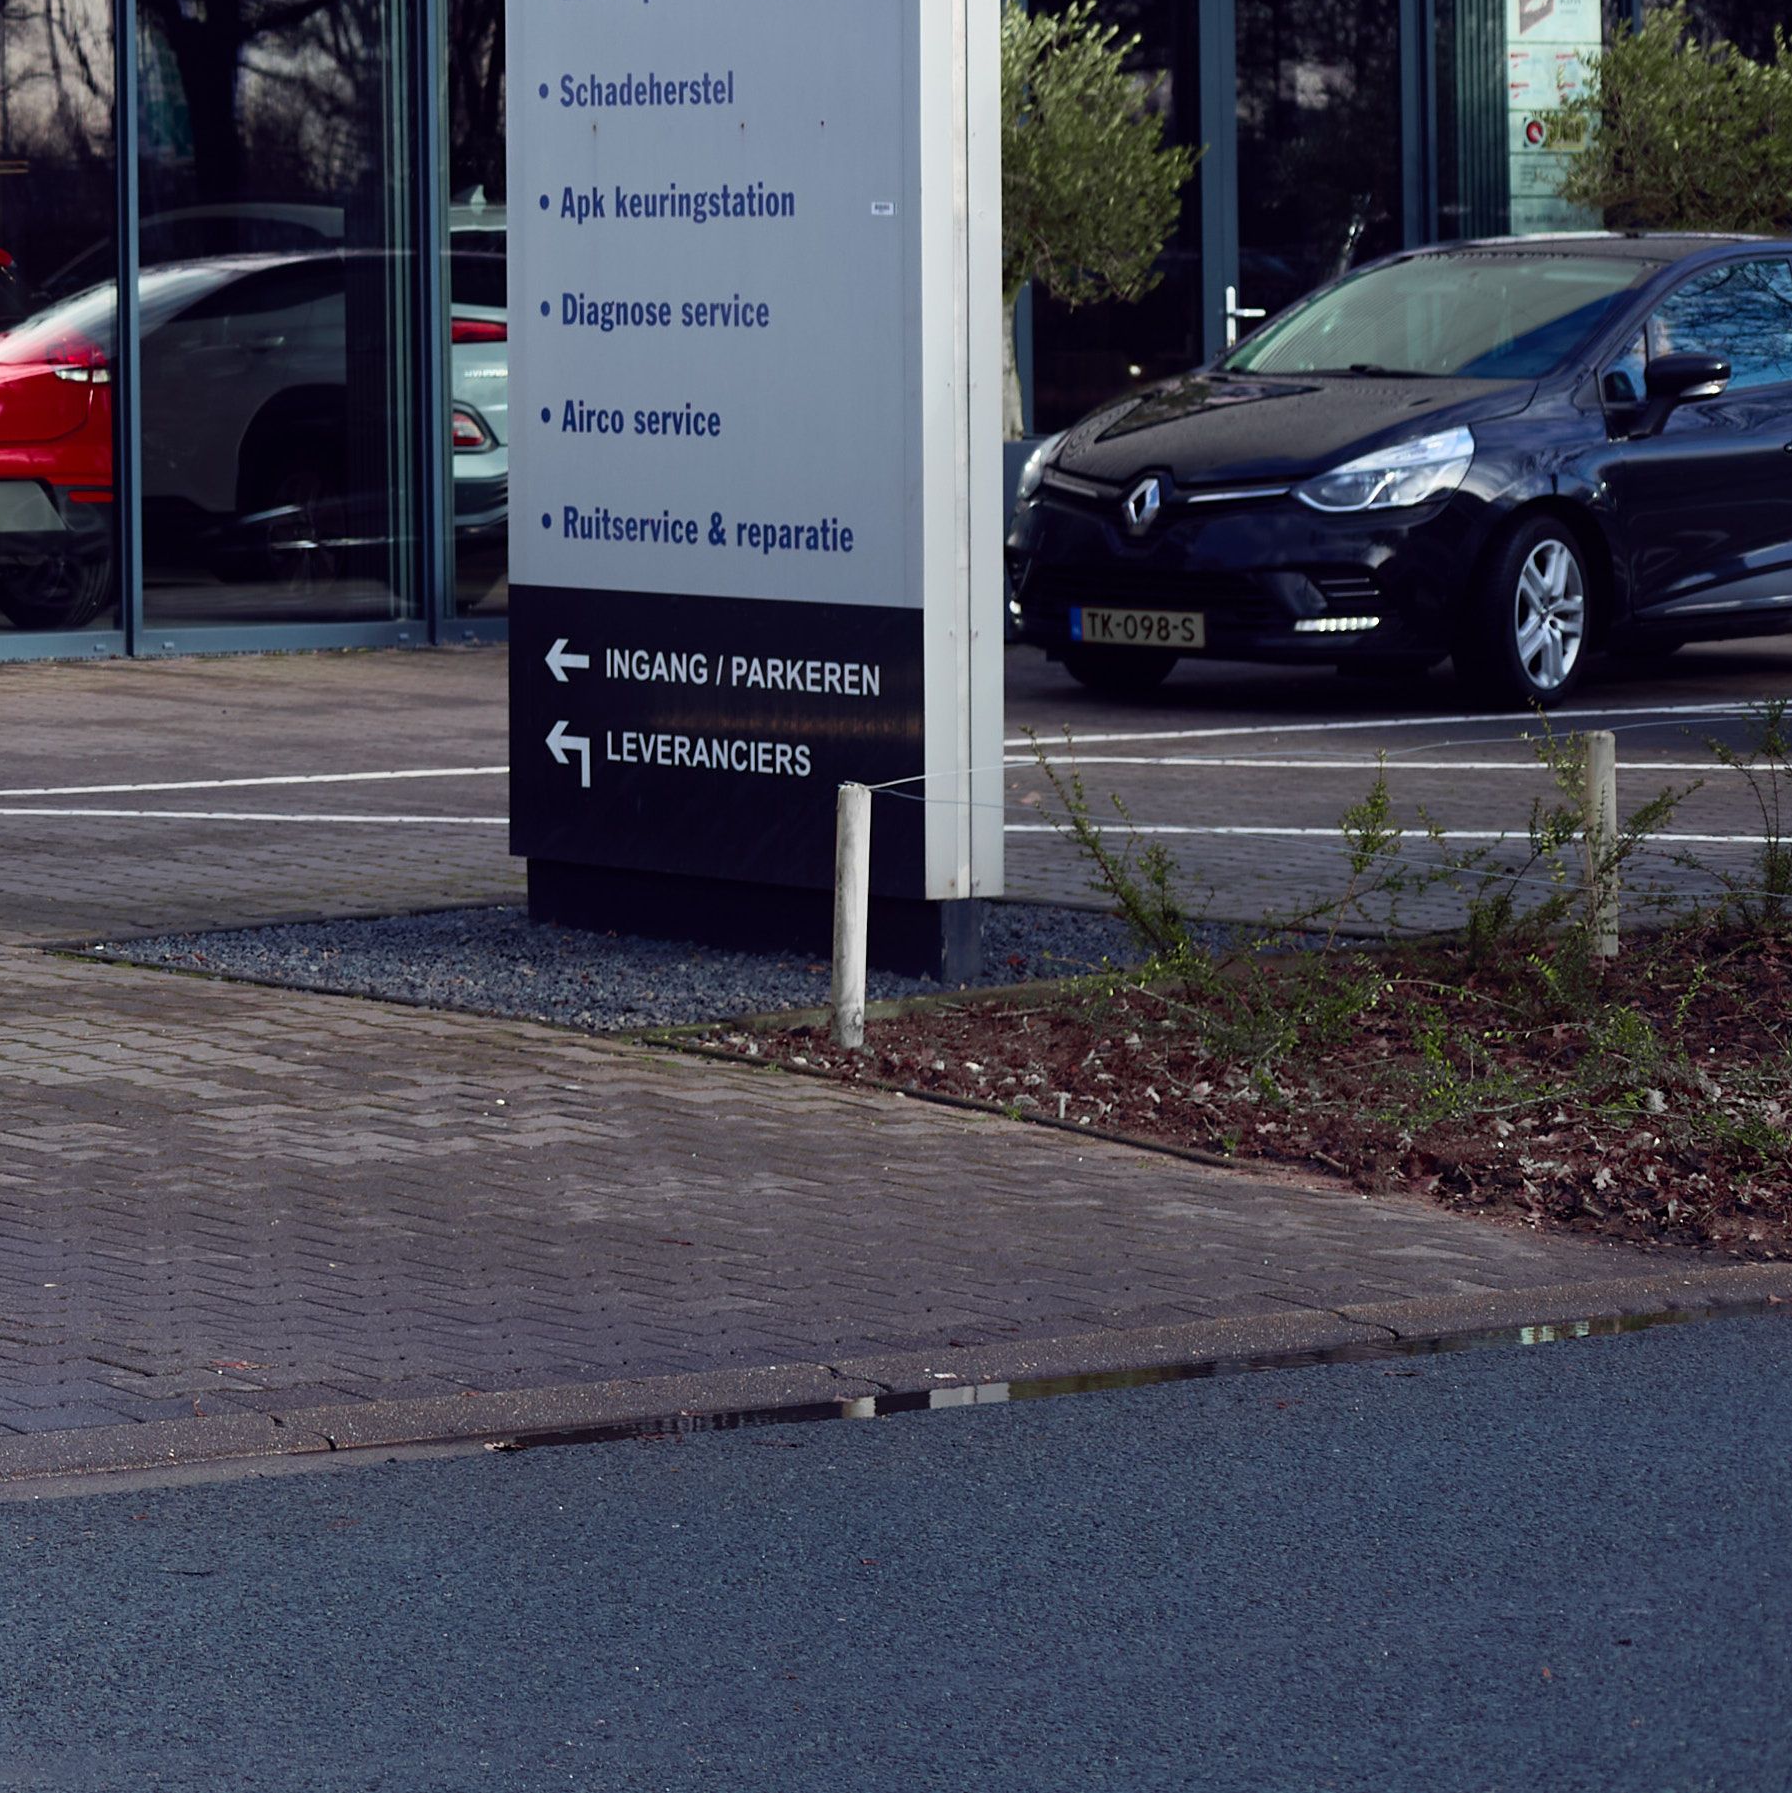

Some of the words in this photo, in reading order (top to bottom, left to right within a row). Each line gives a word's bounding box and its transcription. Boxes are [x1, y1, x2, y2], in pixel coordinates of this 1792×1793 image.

[560, 70, 734, 108] Schadeherstel
[560, 186, 606, 224] Apk
[615, 181, 795, 224] keuringstation
[562, 292, 672, 332] Diagnose
[681, 293, 770, 327] service
[561, 399, 624, 434] Airco
[633, 402, 721, 437] service
[563, 505, 699, 545] Ruitservice
[708, 511, 727, 547] &
[737, 518, 854, 555] reparatie
[1087, 612, 1195, 643] TK-098-S
[606, 648, 709, 685] INGANG
[715, 655, 723, 686] /
[731, 656, 880, 696] PARKEREN
[606, 730, 811, 778] LEVERANCIERS
